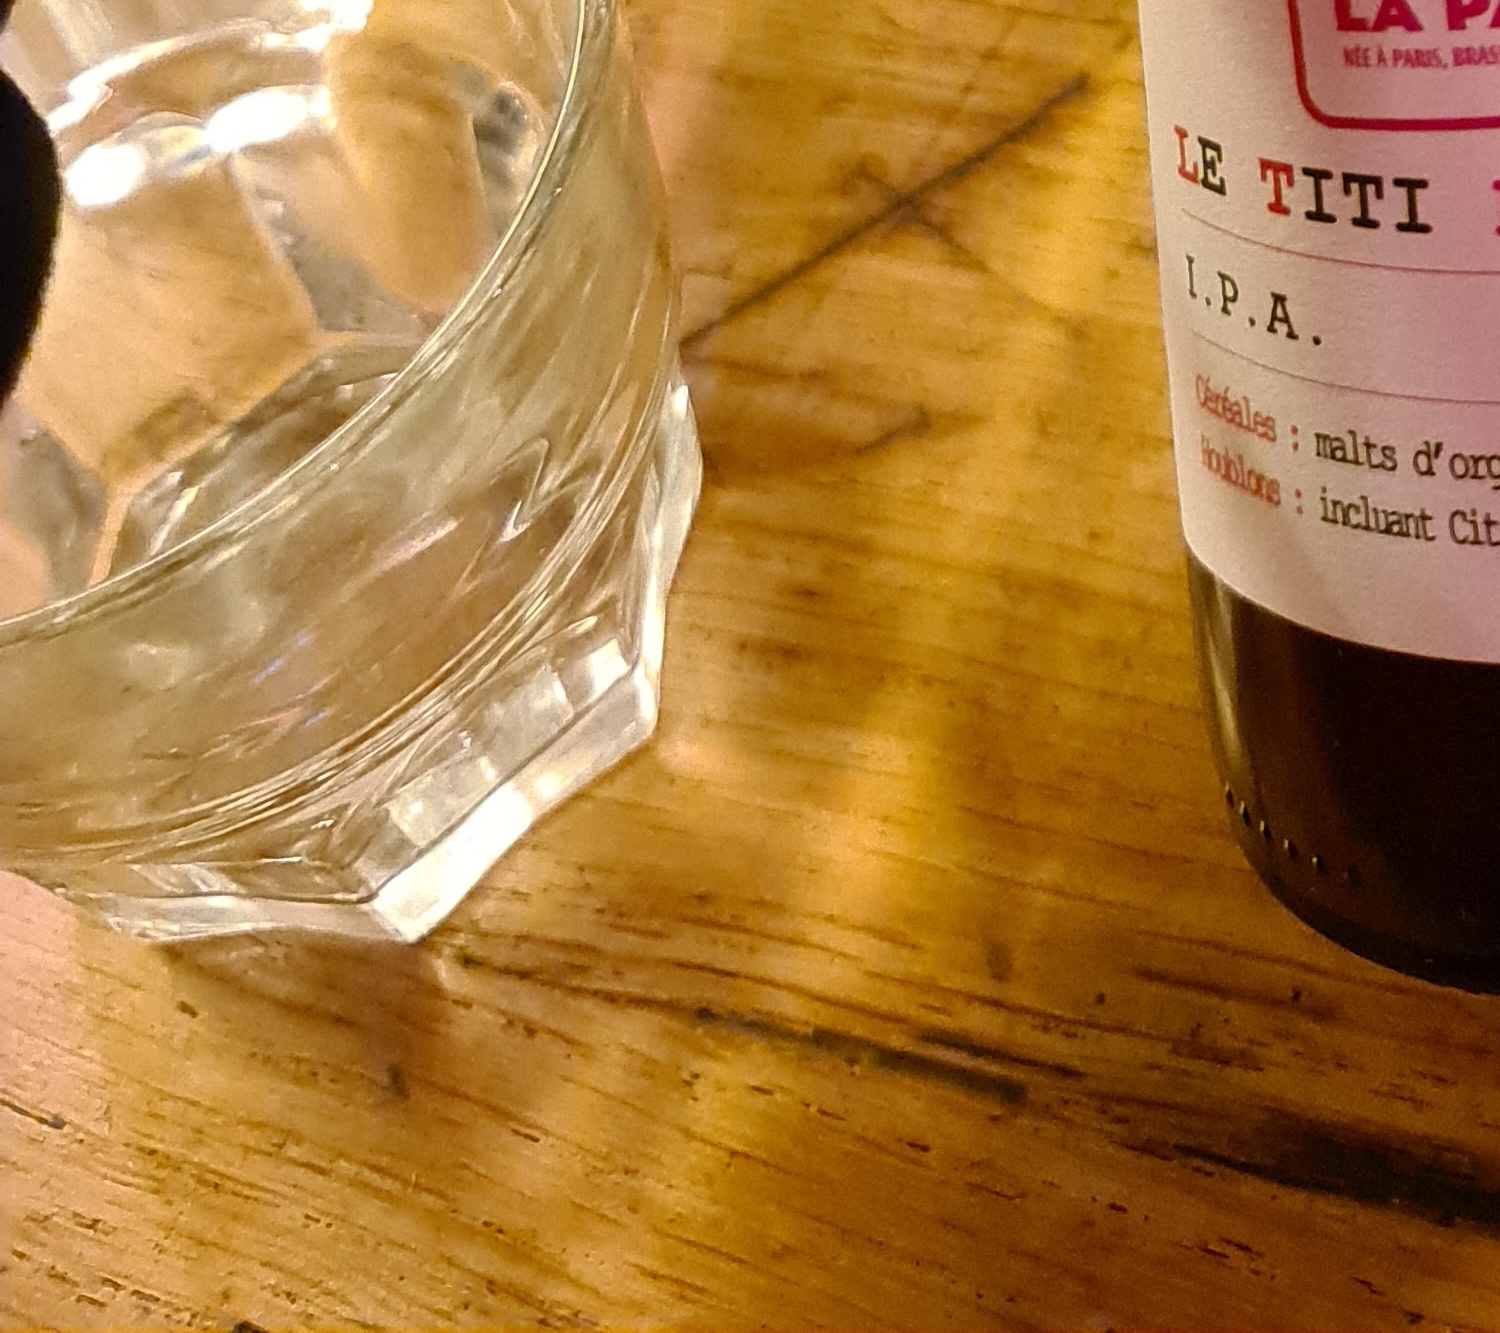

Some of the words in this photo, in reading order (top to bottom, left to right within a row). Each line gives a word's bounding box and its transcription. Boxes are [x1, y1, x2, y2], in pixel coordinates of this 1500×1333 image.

[1343, 43, 1371, 68] NÉE
[1392, 47, 1448, 69] PARIS,
[1174, 124, 1226, 196] LE
[1258, 157, 1433, 234] TITI
[1185, 253, 1322, 346] I.P.A.
[1195, 373, 1277, 442] Céréales
[1315, 430, 1397, 471] malts
[1320, 488, 1436, 541] incluant
